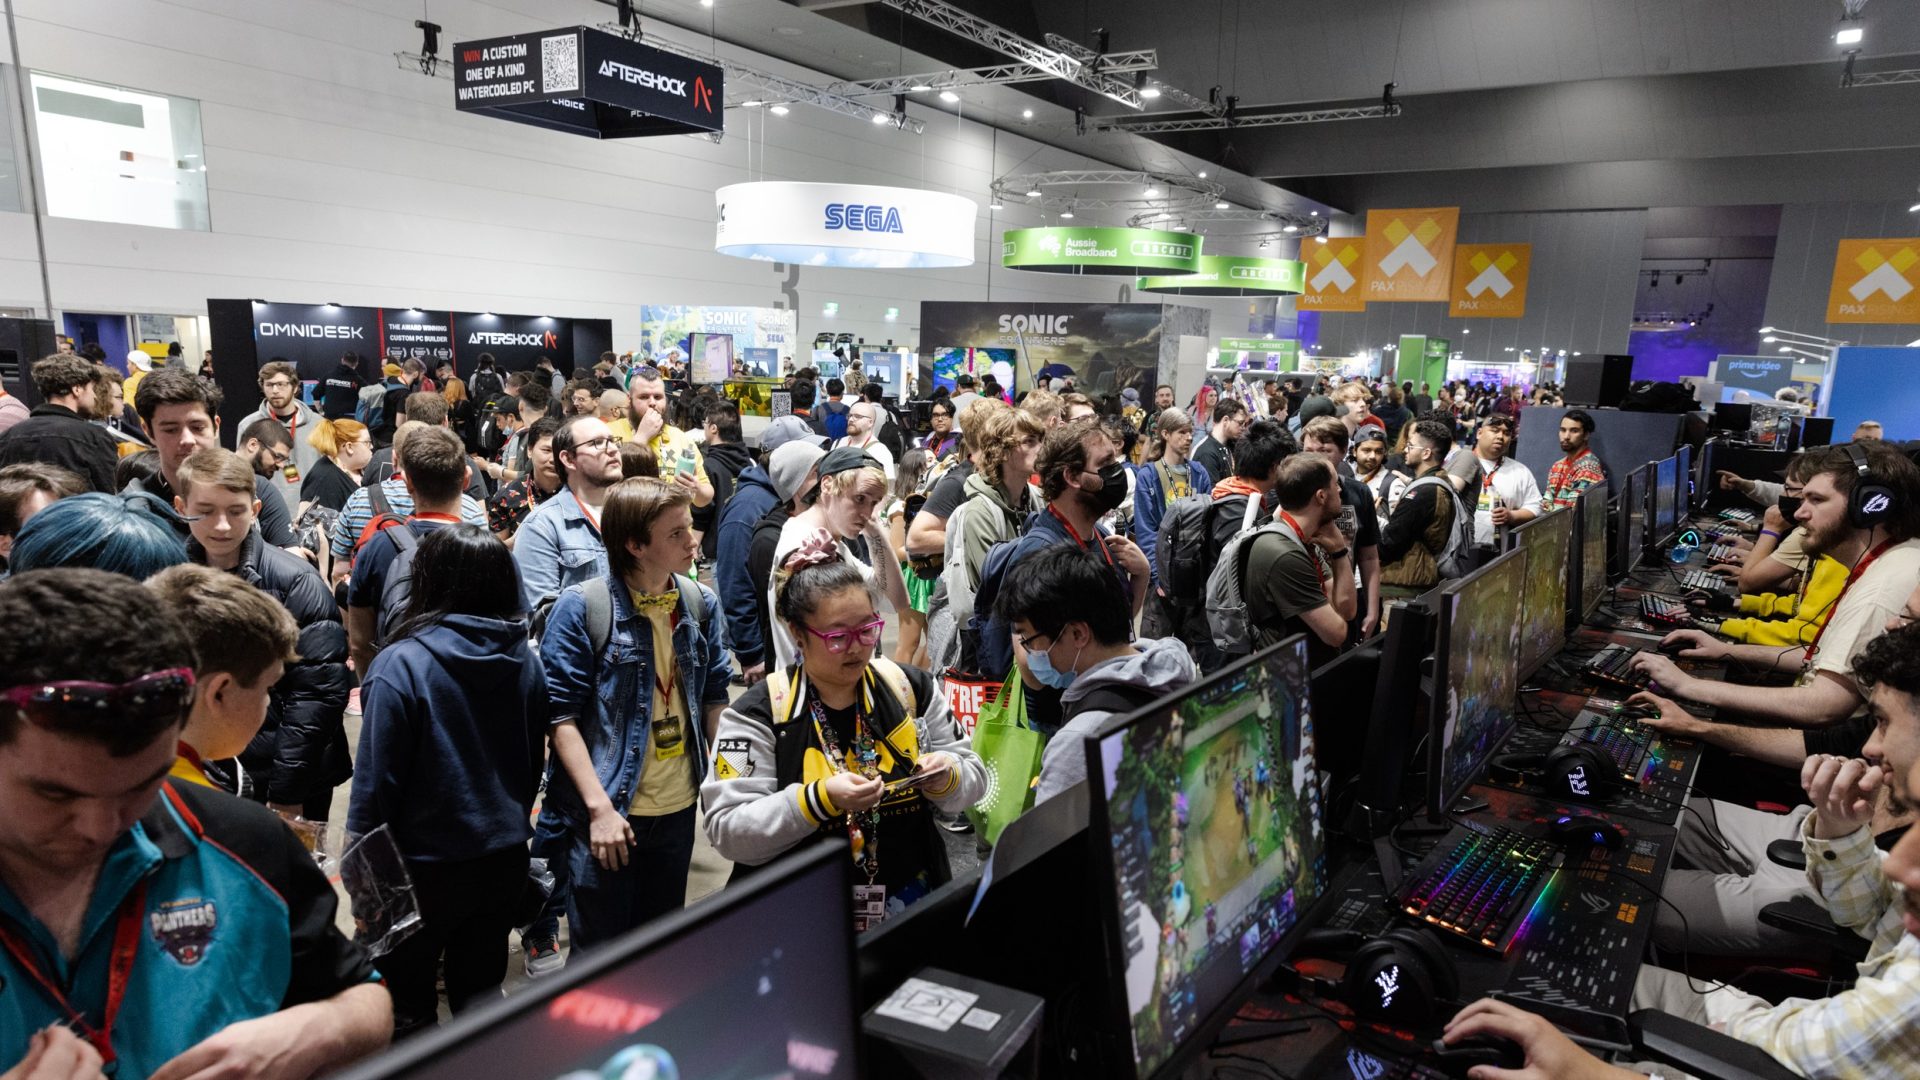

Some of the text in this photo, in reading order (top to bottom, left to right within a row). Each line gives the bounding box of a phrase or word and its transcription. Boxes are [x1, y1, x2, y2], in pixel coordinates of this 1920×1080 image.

[464, 43, 527, 62] WIN A CUSTOM
[466, 62, 525, 81] ONE OF A KIND
[598, 59, 687, 97] AFTERSHOCK
[459, 80, 535, 100] WATERCOOLED PC
[824, 203, 904, 233] SEGA
[1065, 238, 1098, 247] Aussie
[1065, 247, 1118, 257] Broadband
[1141, 242, 1188, 257] ARCADE
[1370, 281, 1395, 291] PAX
[1304, 295, 1323, 304] PAX
[1459, 300, 1478, 310] PAX
[1838, 304, 1865, 314] PAX
[706, 312, 747, 325] SONIC
[260, 323, 364, 339] OMNIDESK
[468, 332, 543, 346] AFTERSHOCK
[1728, 360, 1781, 371] prime video
[945, 680, 983, 714] WE'RE
[719, 741, 748, 750] PAX
[720, 764, 730, 775] A
[151, 903, 216, 937] PANTHERS
